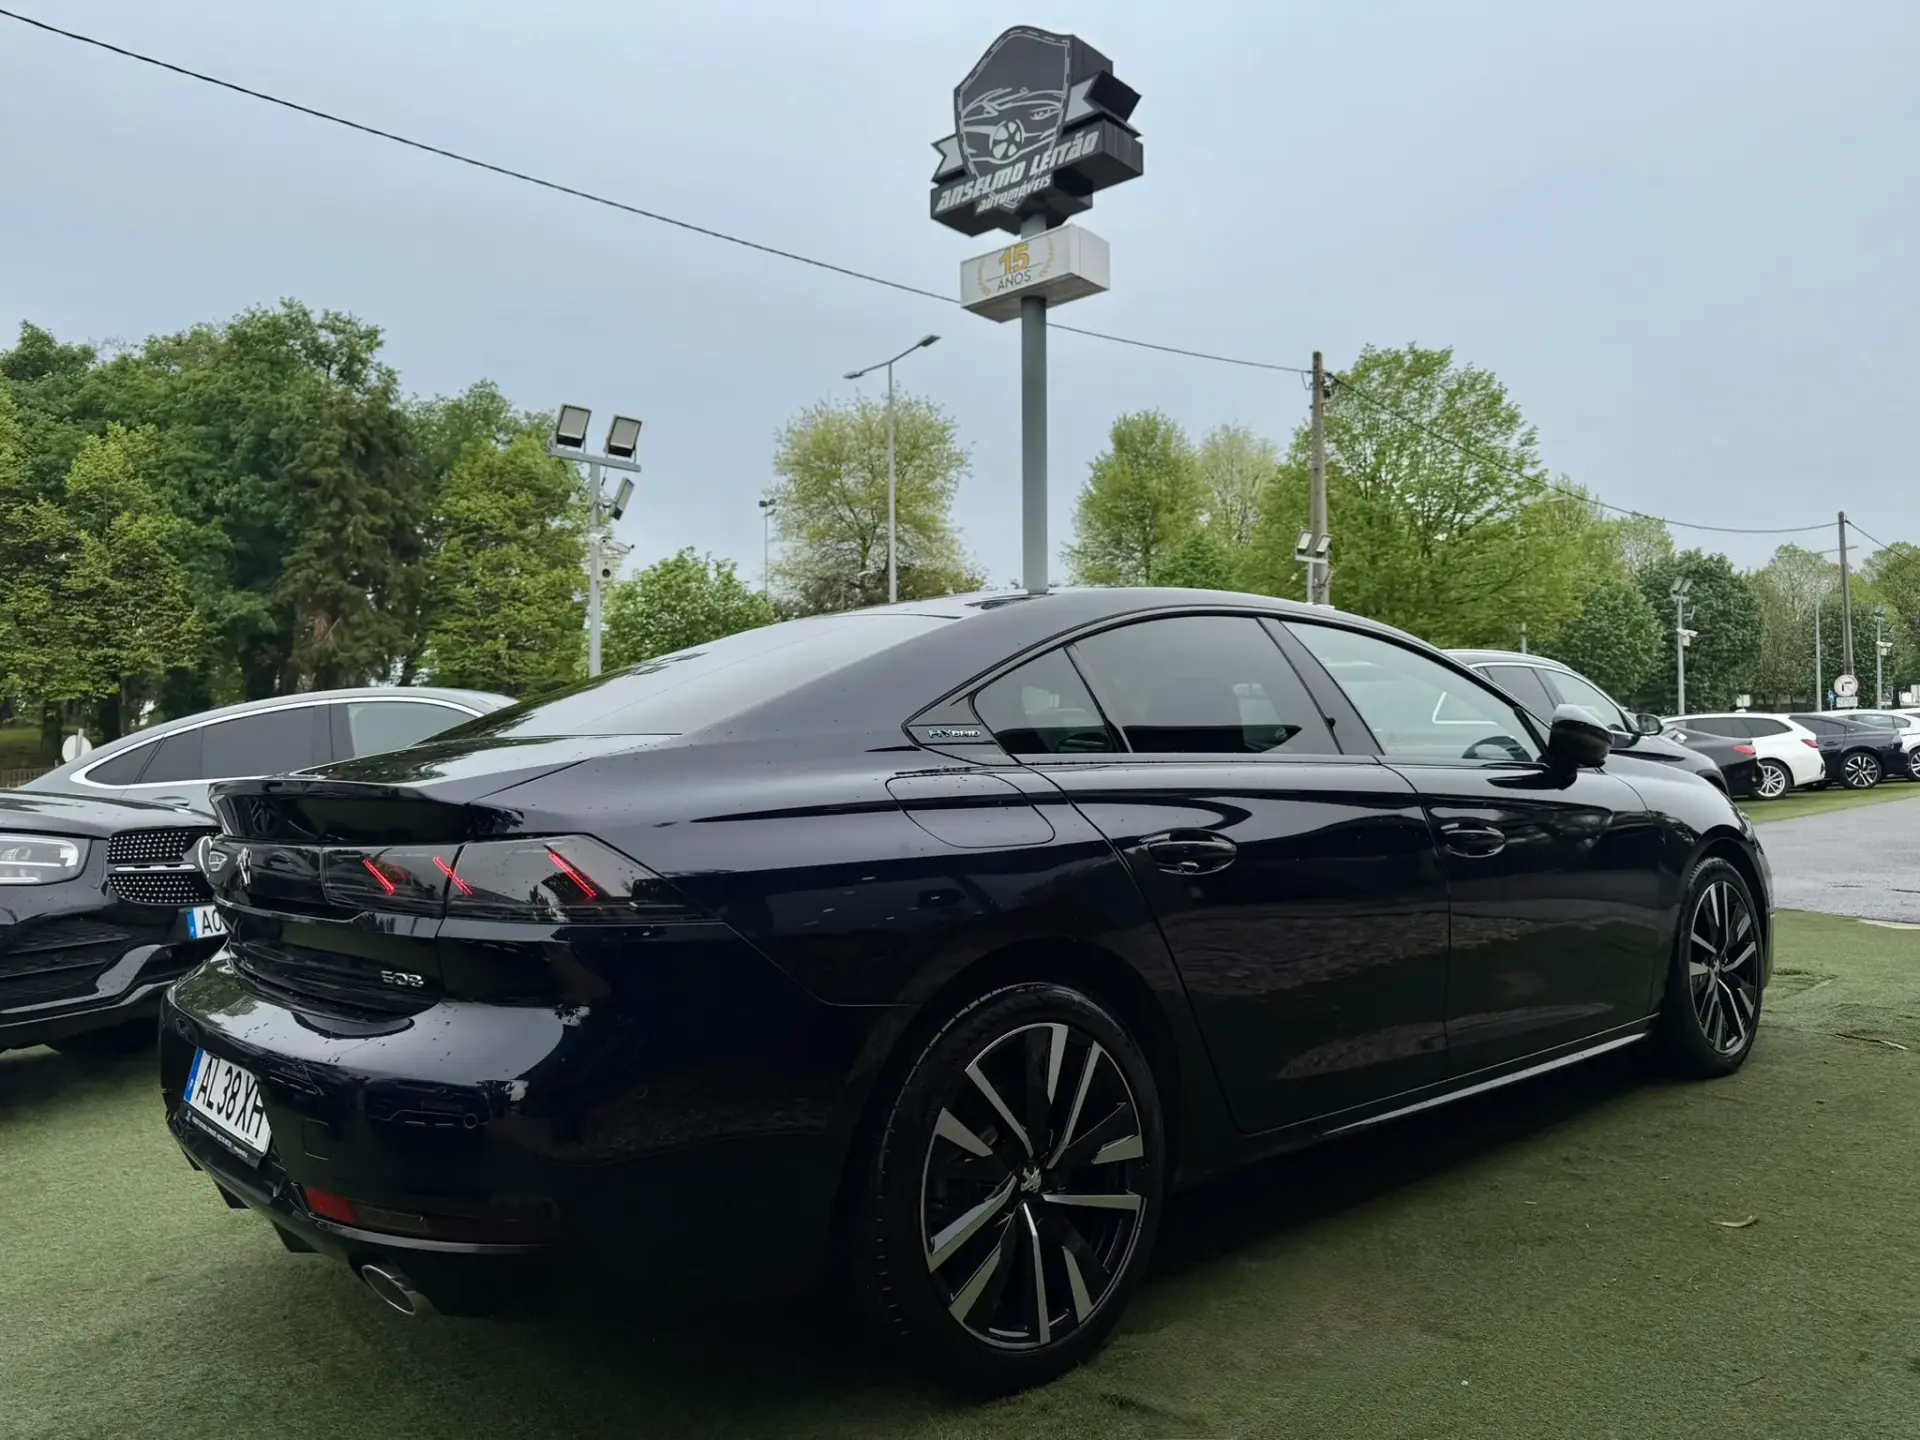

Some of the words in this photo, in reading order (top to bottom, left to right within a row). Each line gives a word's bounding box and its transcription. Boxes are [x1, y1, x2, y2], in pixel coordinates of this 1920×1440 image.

[998, 242, 1030, 274] 15
[996, 269, 1032, 292] ANOS
[928, 729, 980, 738] HYBRID
[381, 970, 424, 987] 508
